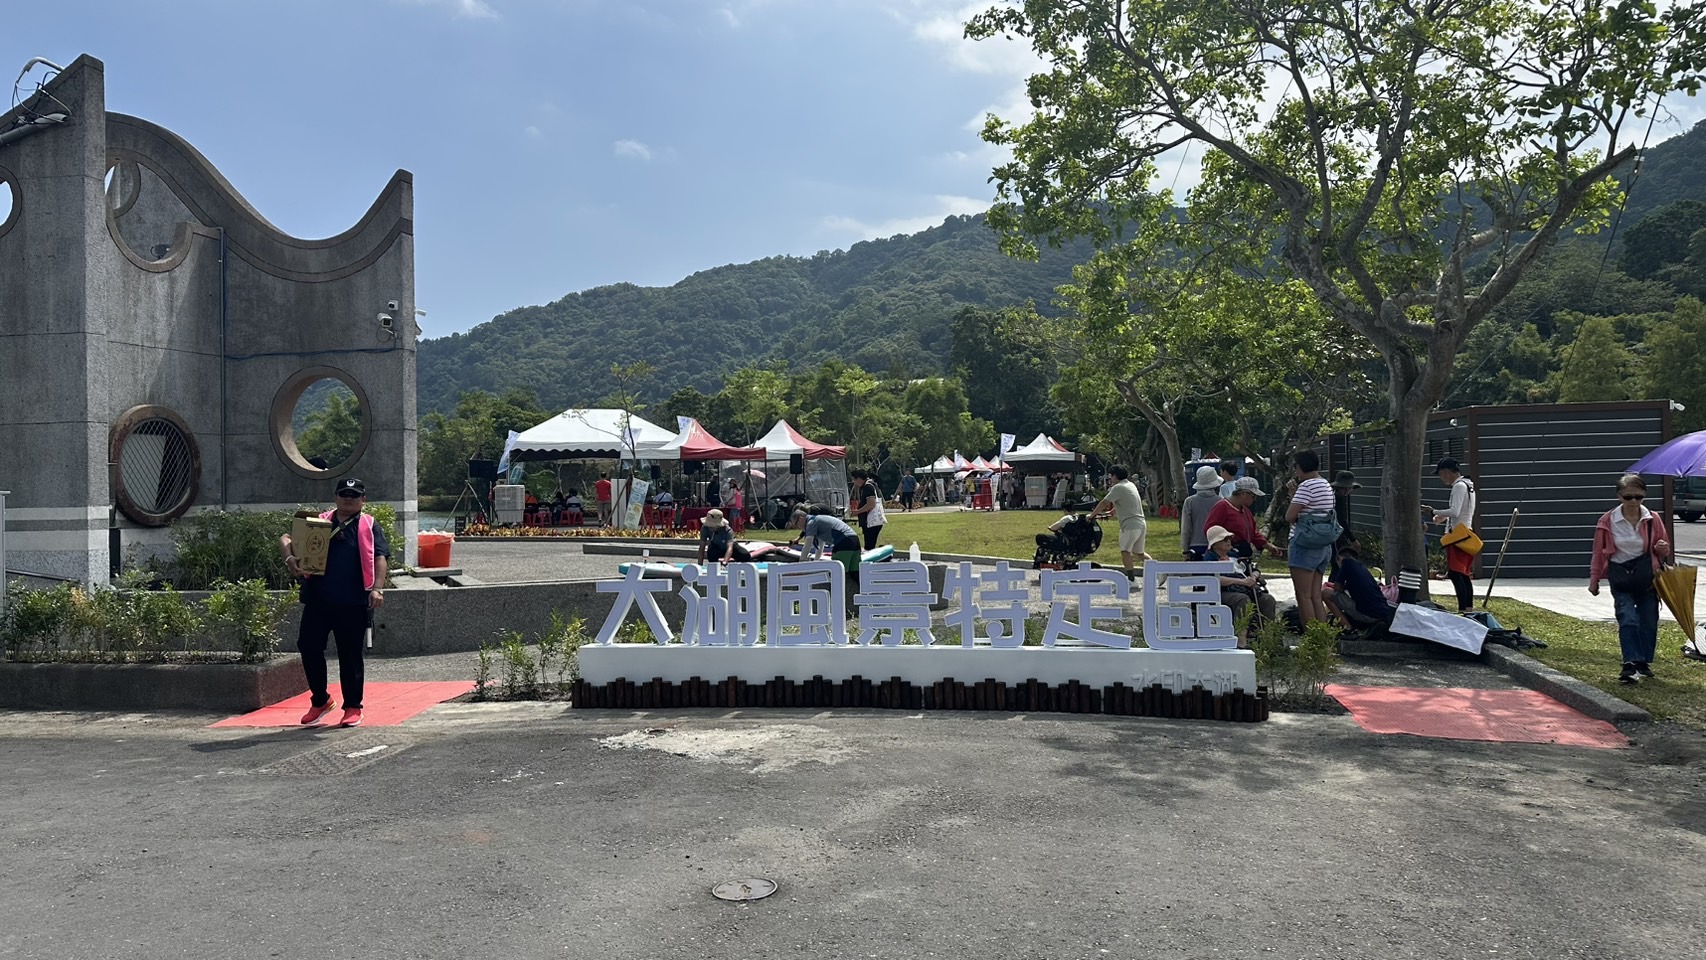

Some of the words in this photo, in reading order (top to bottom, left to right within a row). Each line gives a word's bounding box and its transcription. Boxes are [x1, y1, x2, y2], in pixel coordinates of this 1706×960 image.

[595, 560, 1238, 649] 大湖風景特定區
